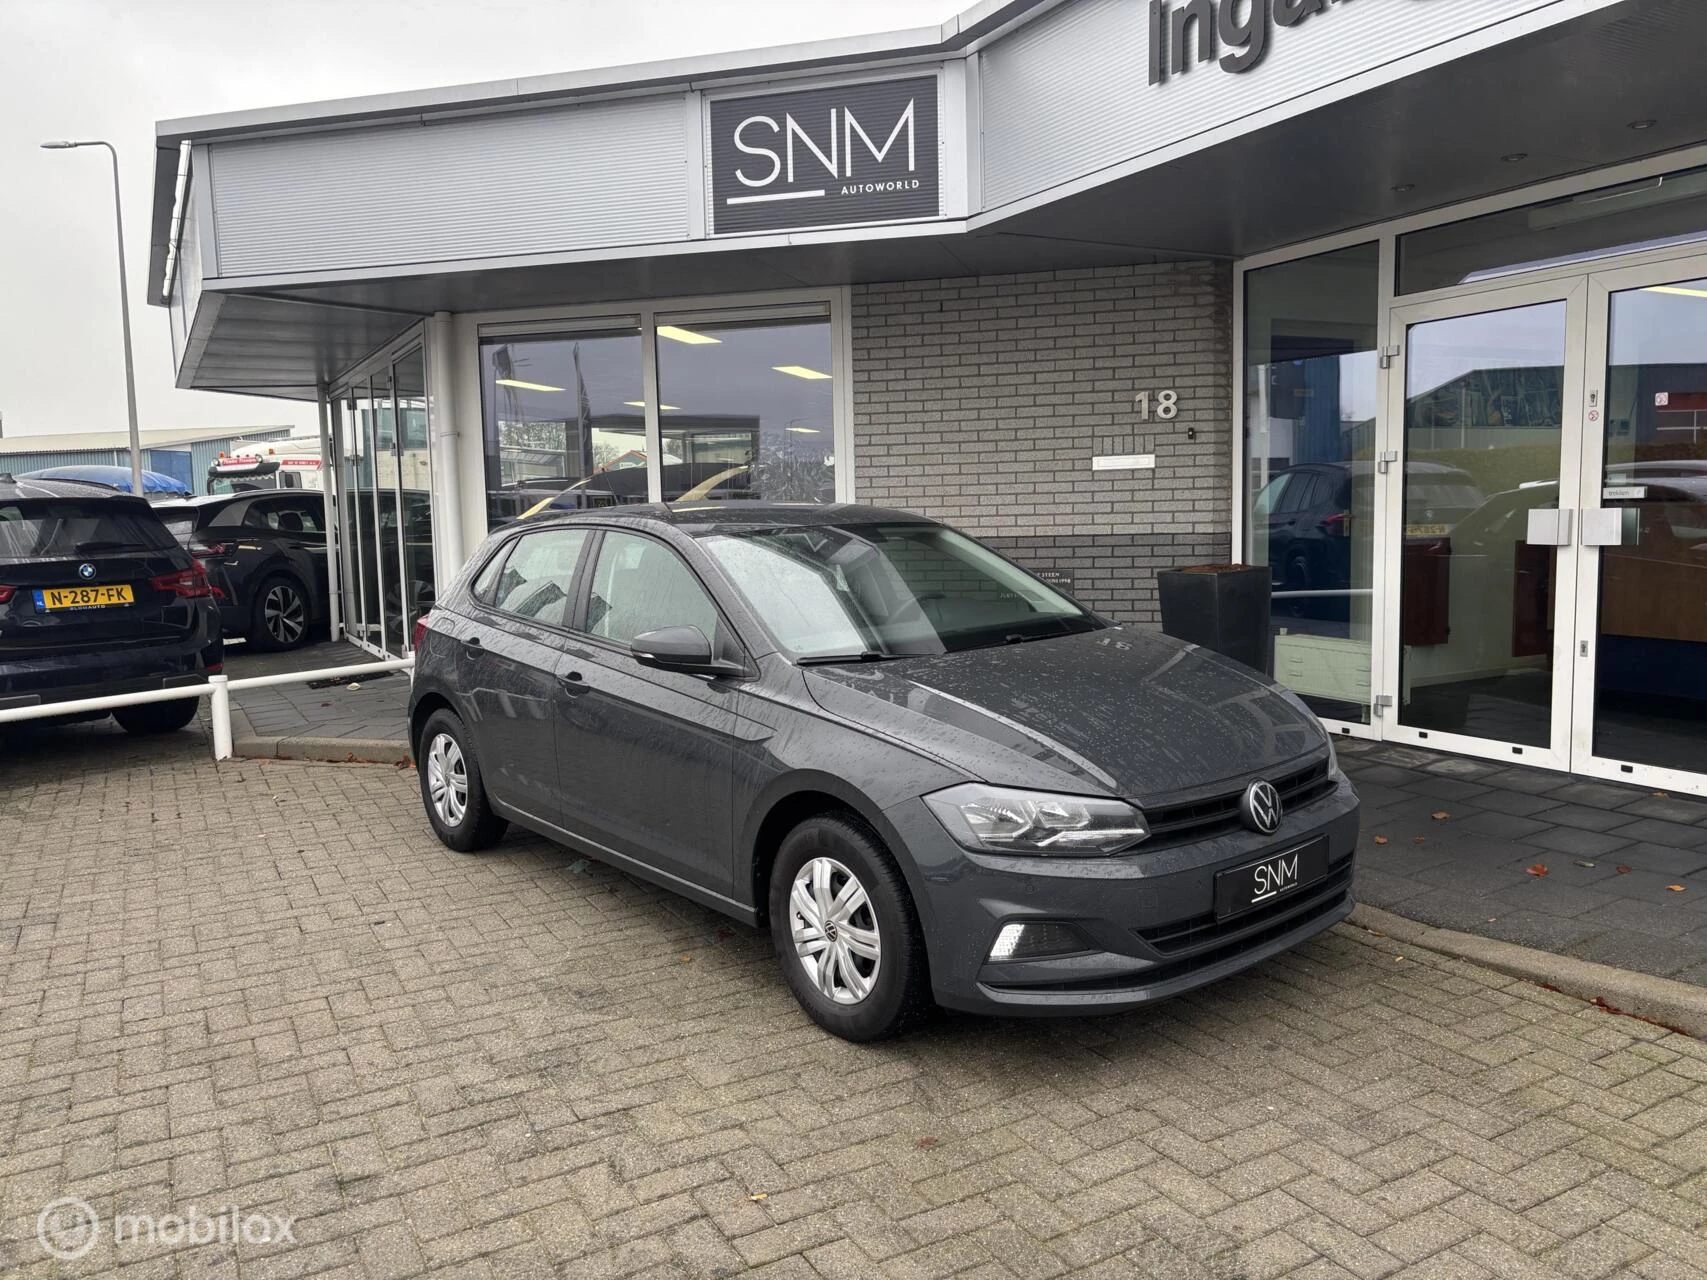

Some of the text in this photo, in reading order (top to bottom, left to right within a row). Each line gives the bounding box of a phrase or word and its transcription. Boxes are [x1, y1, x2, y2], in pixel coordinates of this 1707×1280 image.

[1148, 0, 1342, 86] Ing
[733, 97, 915, 188] SNM
[841, 179, 920, 195] AUTOWORLD
[1135, 390, 1178, 421] 18
[51, 587, 127, 606] N-287-FK
[1253, 854, 1298, 895] SNM
